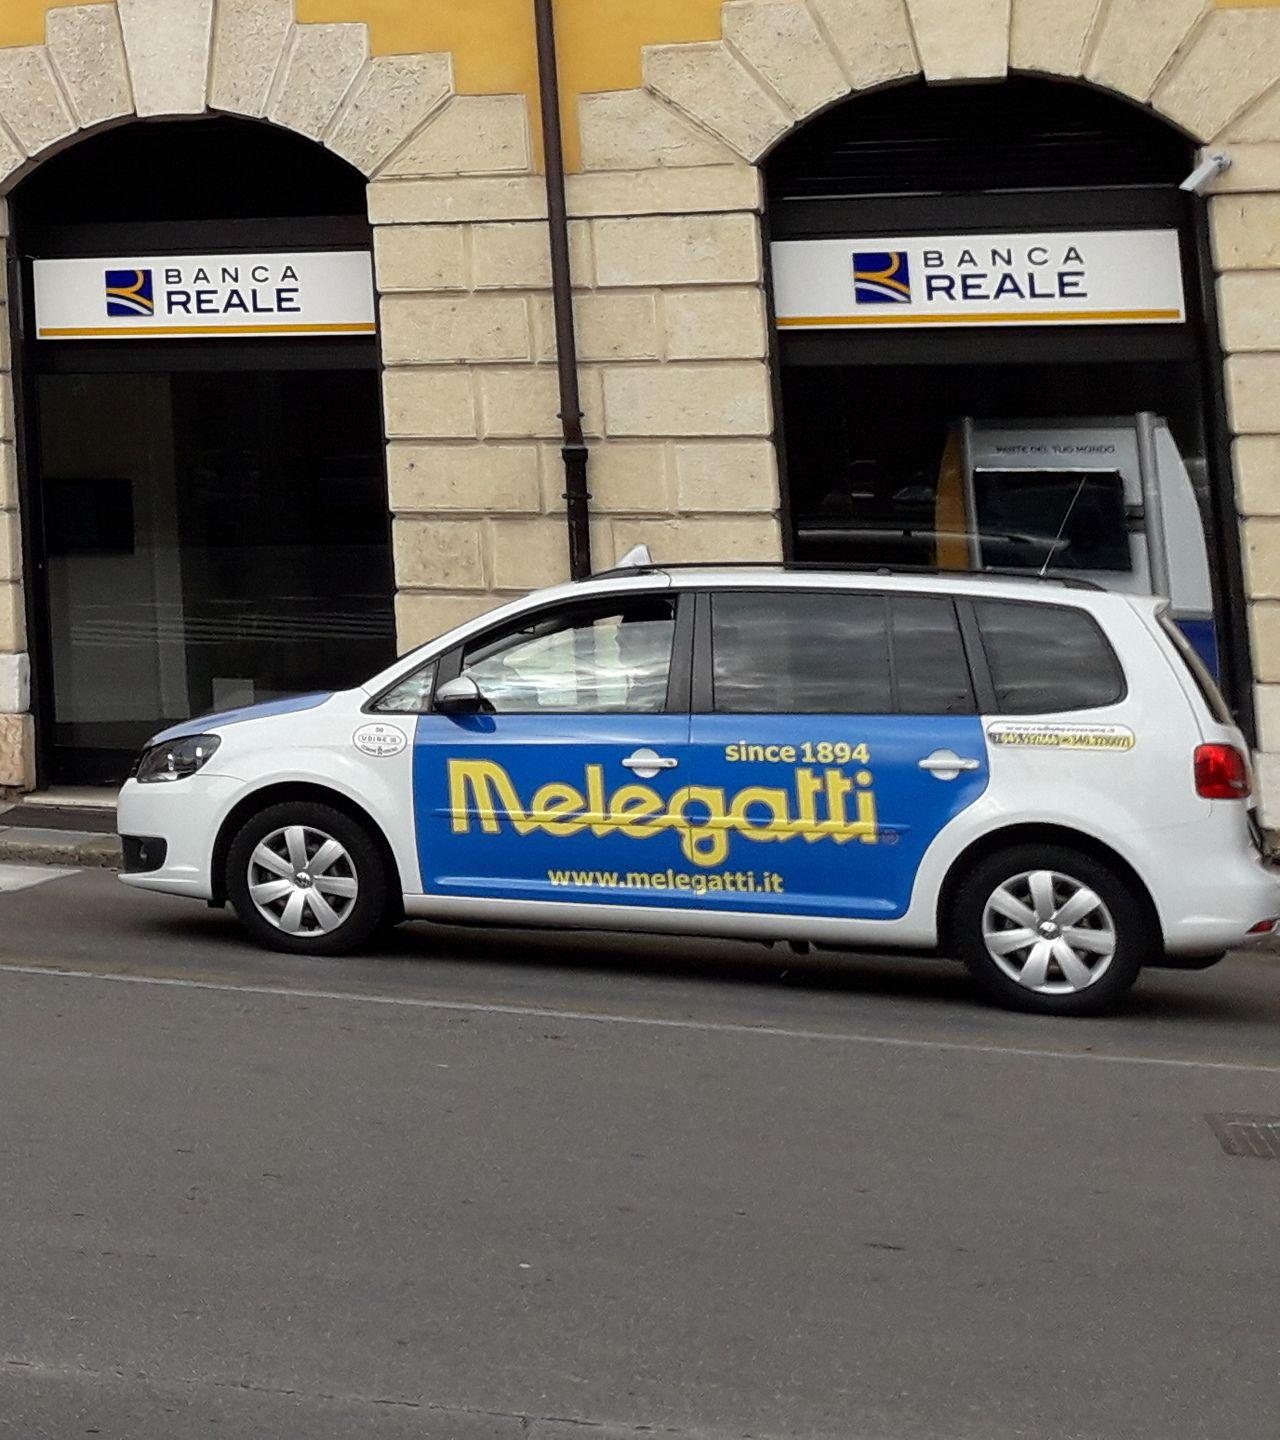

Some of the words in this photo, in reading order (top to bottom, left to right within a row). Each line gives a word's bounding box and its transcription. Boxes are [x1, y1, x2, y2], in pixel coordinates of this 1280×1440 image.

[923, 246, 1085, 268] BANCA
[165, 265, 299, 285] BANCA
[925, 271, 1088, 301] REALE
[166, 287, 301, 314] REALE
[724, 740, 797, 763] since
[800, 742, 871, 765] 1894
[446, 757, 878, 867] Melegatti
[547, 867, 784, 895] www.melegatti.it
